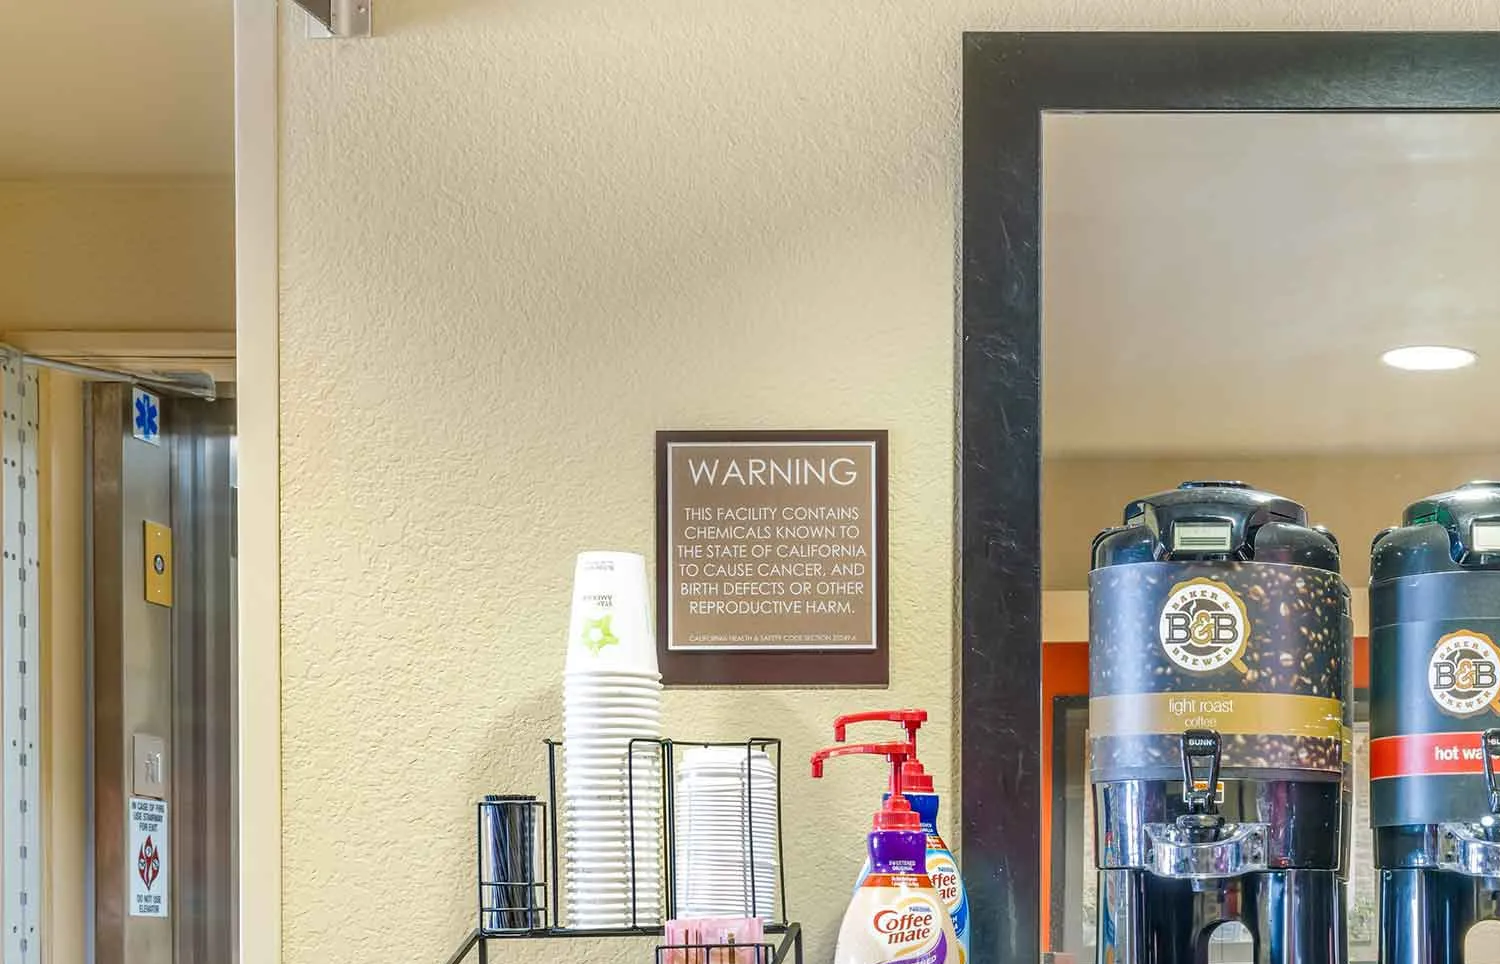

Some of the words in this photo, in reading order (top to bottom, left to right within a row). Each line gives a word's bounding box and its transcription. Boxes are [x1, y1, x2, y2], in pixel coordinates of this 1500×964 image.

[688, 458, 858, 486] WARNING
[684, 507, 713, 521] THIS
[716, 507, 778, 521] FACILITY
[782, 506, 860, 521] CONTAINS
[684, 525, 772, 540] CHEMICALS
[776, 525, 835, 540] KNOWN
[839, 525, 860, 539] TO
[677, 544, 703, 559] THE
[706, 544, 747, 559] STATE
[751, 544, 772, 558] OF
[776, 543, 867, 559] CALIFORNIA
[679, 563, 699, 577] TO
[703, 563, 753, 577] CAUSE
[757, 563, 827, 579] CANCER,
[831, 562, 865, 577] AND
[680, 582, 719, 597] BIRTH
[723, 582, 785, 596] DEFECTS
[789, 582, 812, 596] OR
[816, 582, 864, 596] OTHER
[689, 600, 802, 615] REPRODUCTIVE
[805, 600, 857, 615] HARM.
[1165, 610, 1239, 647] B&B
[1433, 659, 1498, 691] B&B
[1168, 698, 1196, 716] light
[1199, 700, 1234, 713] roast
[1184, 718, 1217, 728] coffee
[1435, 746, 1459, 761] hot
[931, 873, 956, 888] ffee
[939, 887, 957, 899] ate
[873, 909, 933, 934] Coffee
[888, 928, 931, 945] mate
